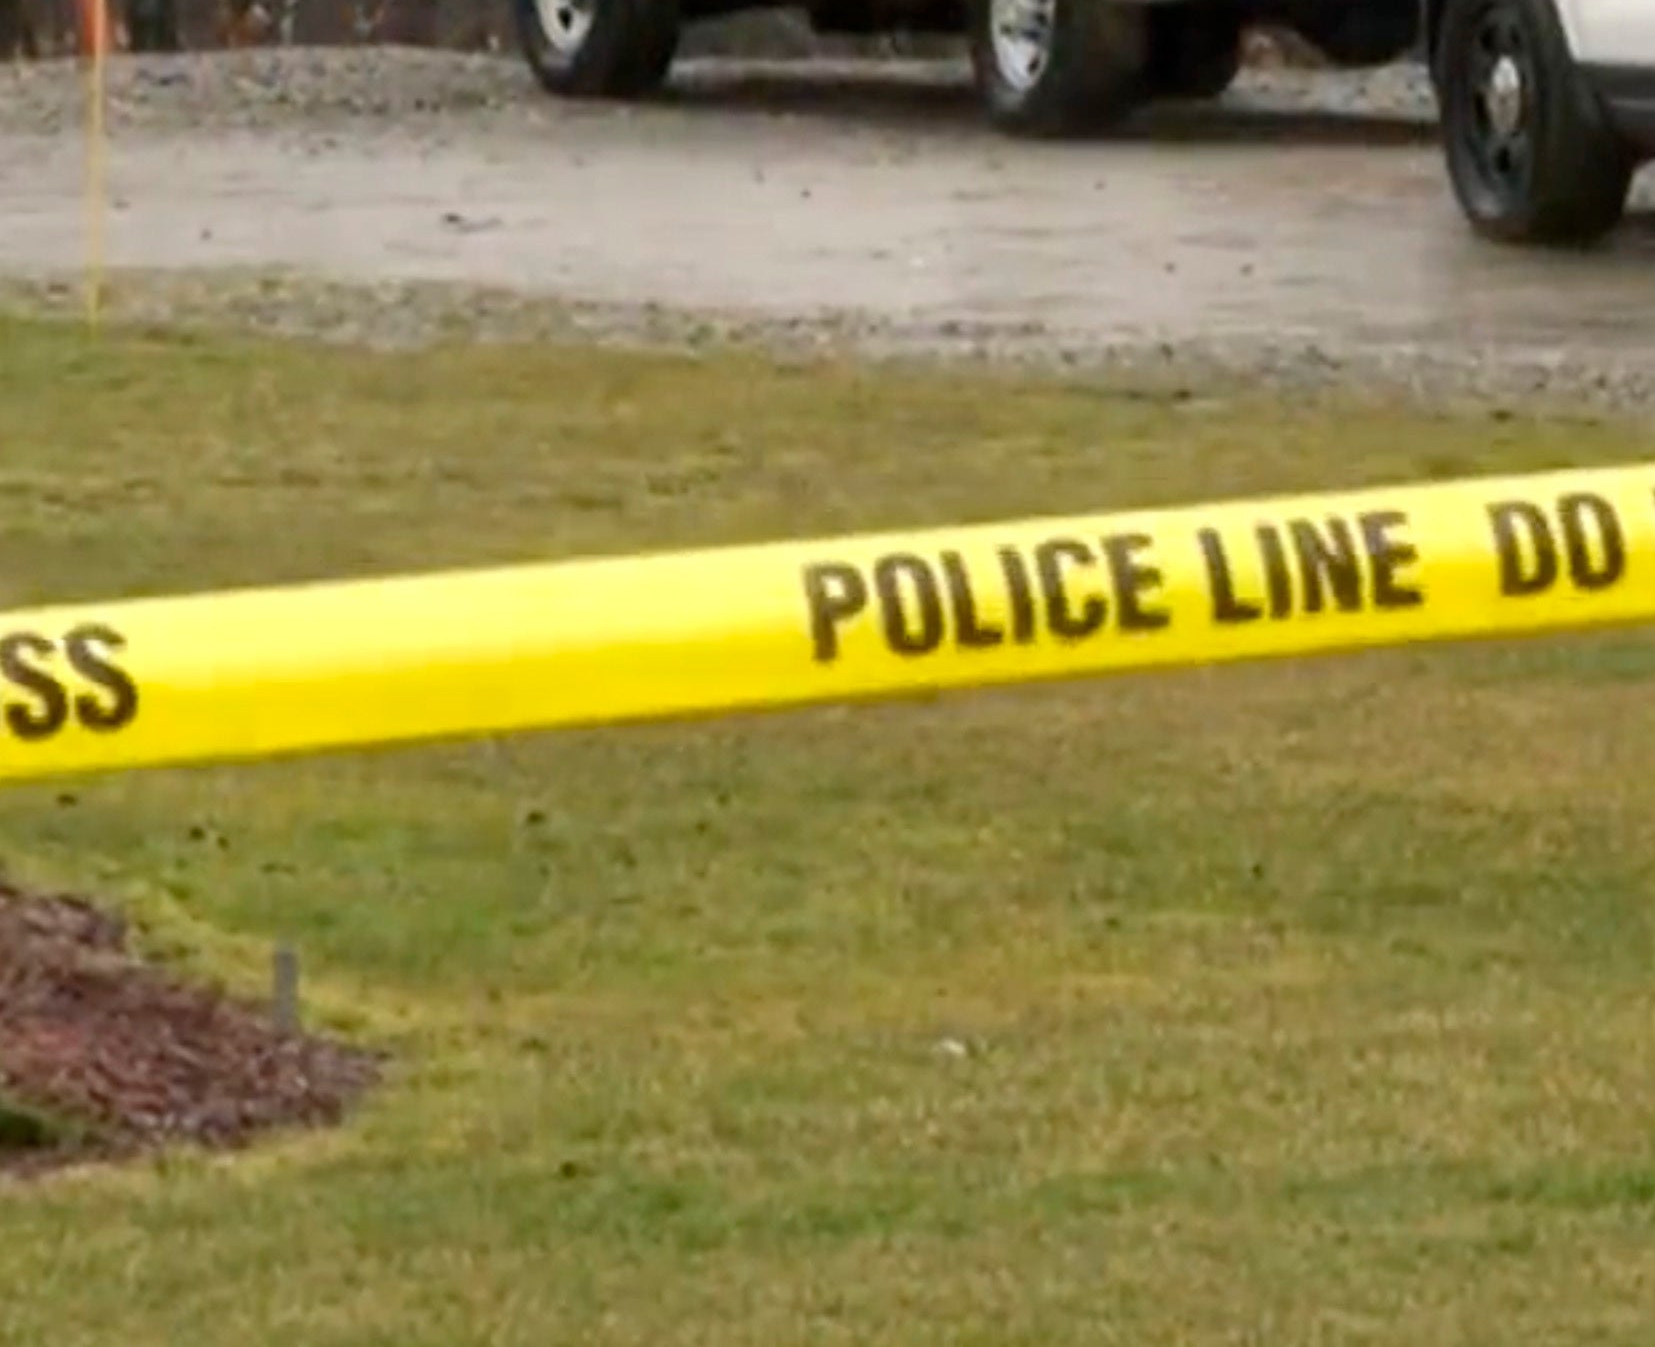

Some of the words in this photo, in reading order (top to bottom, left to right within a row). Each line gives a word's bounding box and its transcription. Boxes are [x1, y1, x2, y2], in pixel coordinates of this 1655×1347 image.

[801, 532, 1171, 666] POLICE
[1196, 510, 1425, 624] LINE
[1486, 490, 1626, 598] DO
